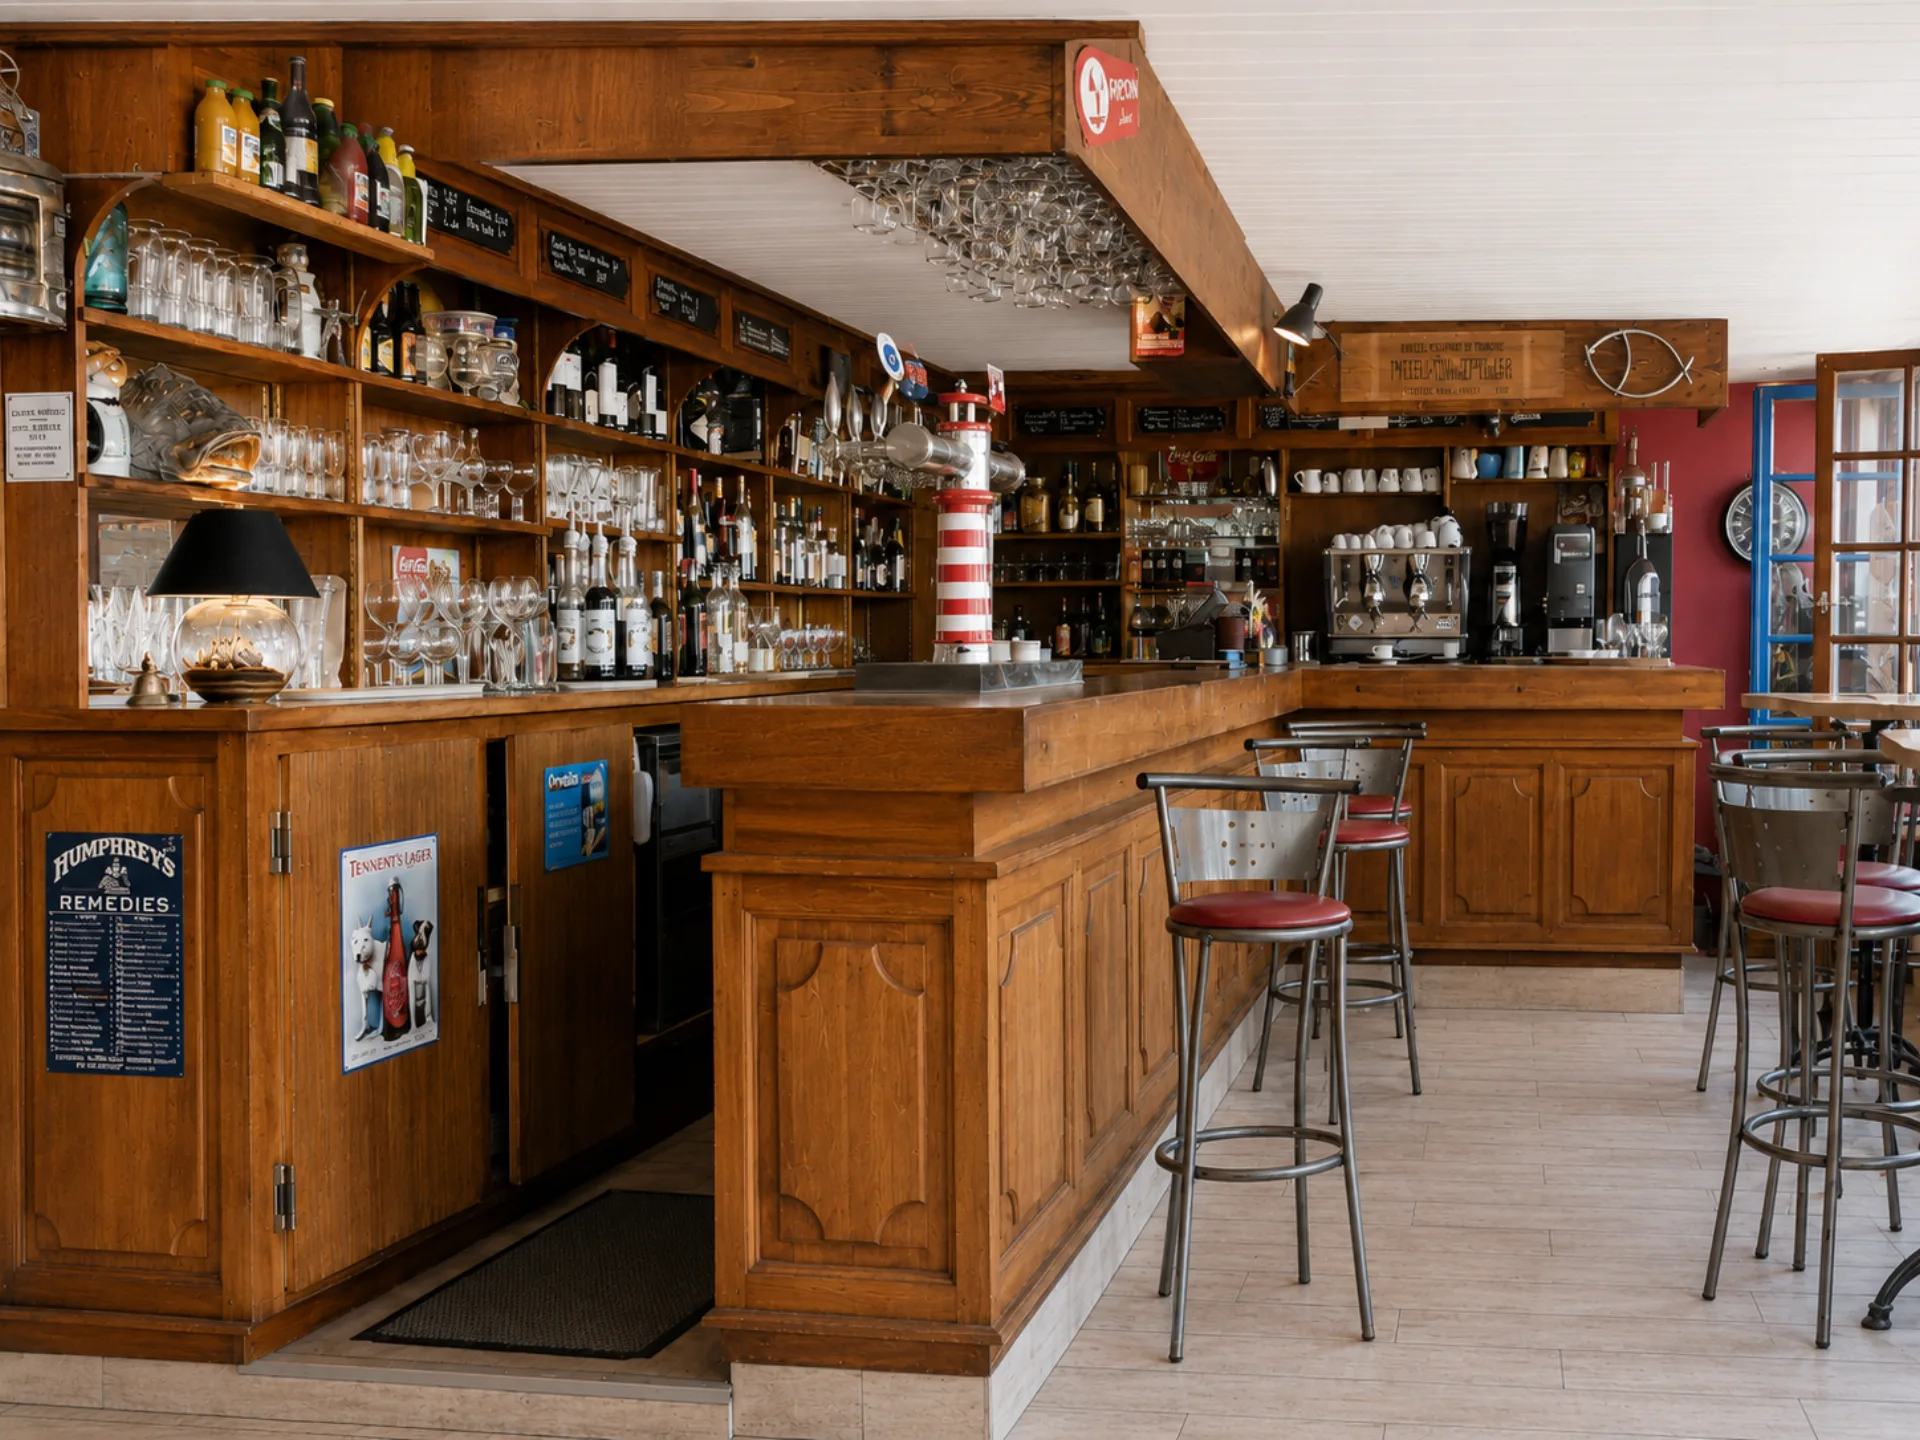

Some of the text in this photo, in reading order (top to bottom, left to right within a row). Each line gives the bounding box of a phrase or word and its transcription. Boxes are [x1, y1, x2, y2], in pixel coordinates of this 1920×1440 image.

[53, 837, 176, 884] HUMPHREY'S
[349, 848, 432, 878] TENNENT'S LAGER
[60, 895, 169, 913] REMEDIES
